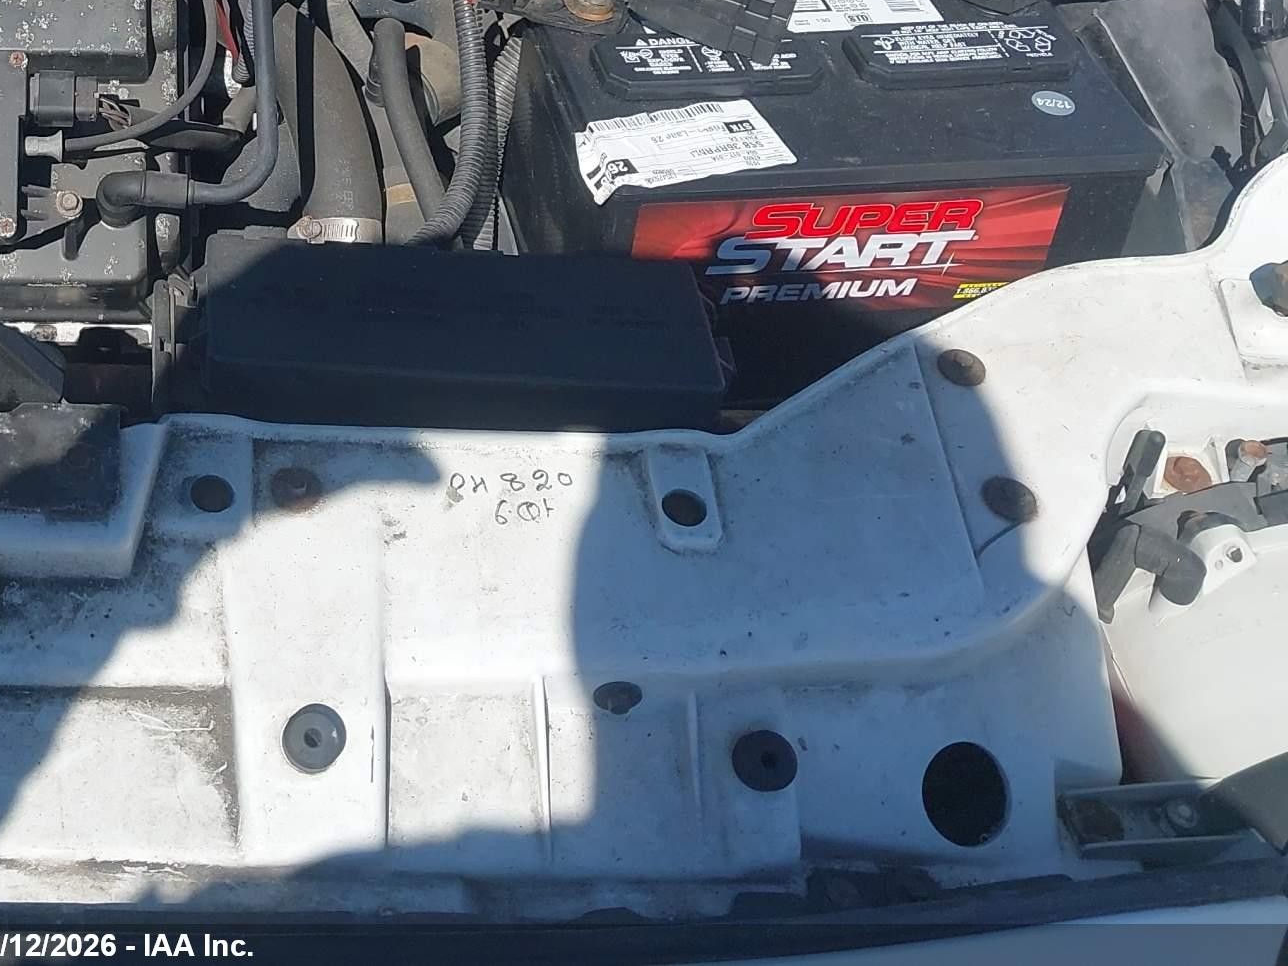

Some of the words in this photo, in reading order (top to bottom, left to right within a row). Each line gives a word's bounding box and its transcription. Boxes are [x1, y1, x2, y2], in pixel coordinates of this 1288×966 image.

[1036, 97, 1072, 109] 12/24
[729, 122, 753, 132] STK
[744, 199, 984, 240] SUPER
[705, 230, 976, 275] START
[720, 278, 918, 305] PREMIUM
